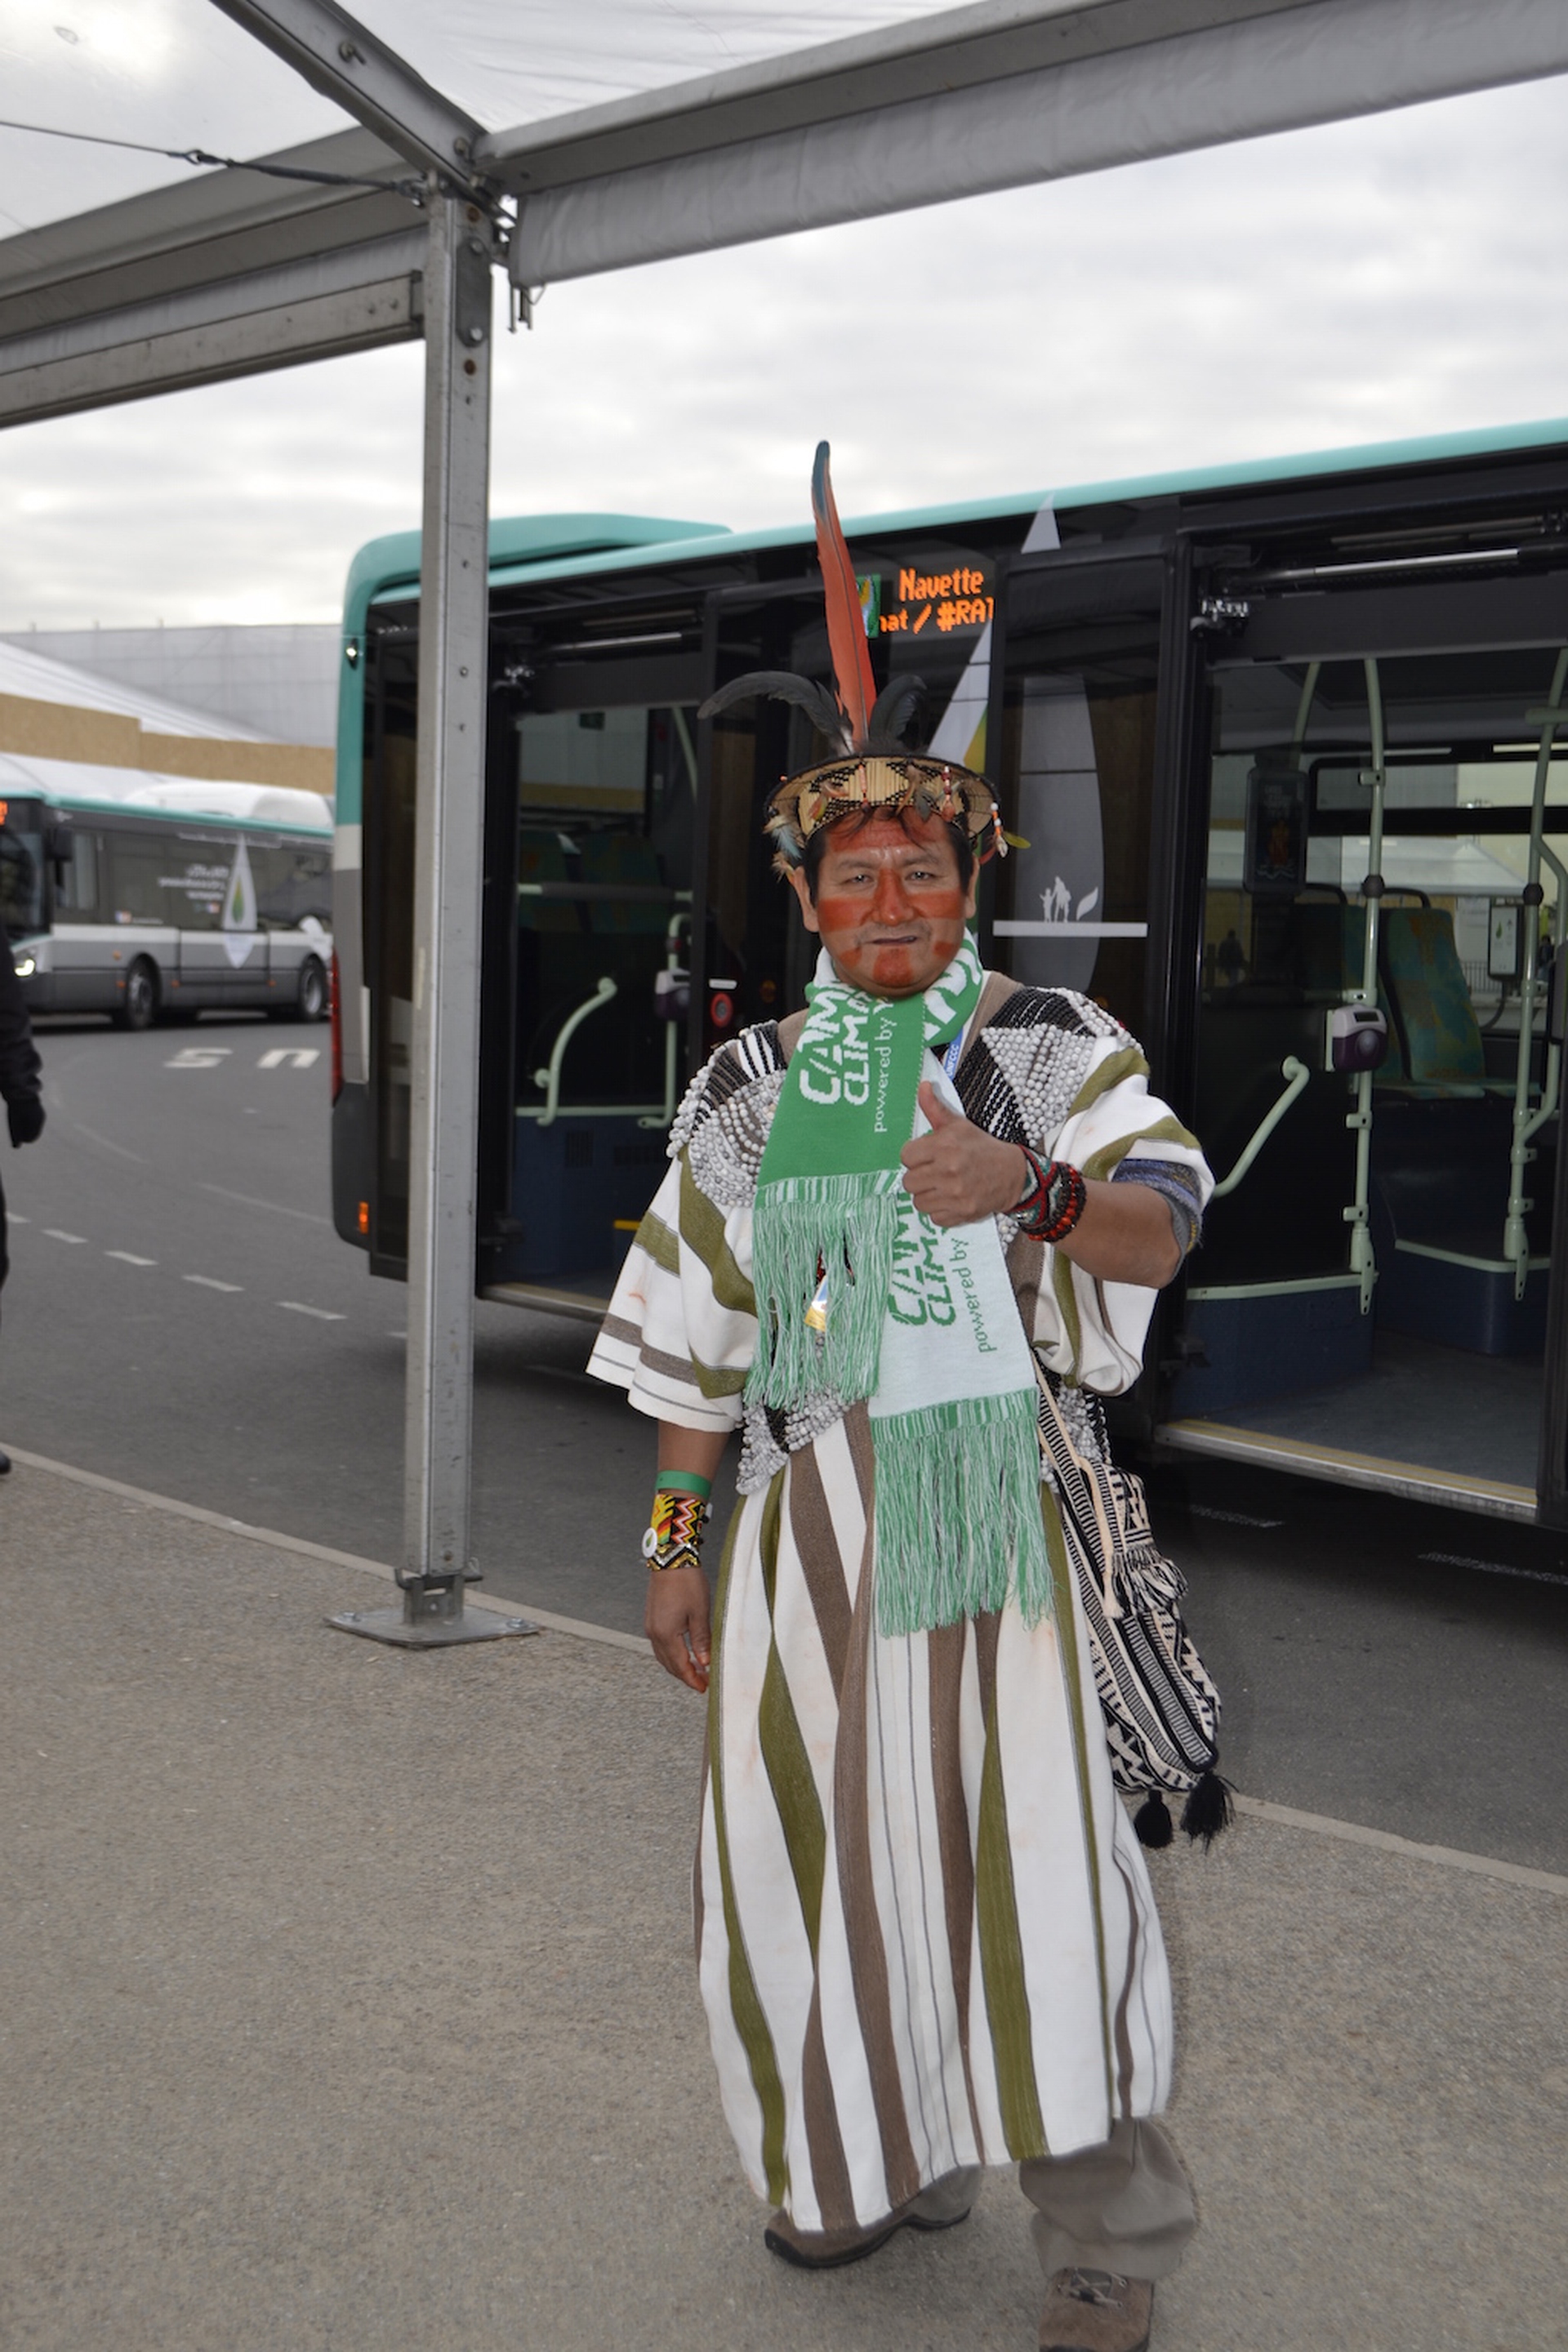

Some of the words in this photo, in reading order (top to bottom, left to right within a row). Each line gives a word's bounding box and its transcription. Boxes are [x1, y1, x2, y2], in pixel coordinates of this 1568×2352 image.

[899, 567, 984, 602] Navette
[875, 1018, 898, 1040] by
[874, 1047, 893, 1133] powered
[949, 1238, 969, 1262] by
[952, 1267, 997, 1352] powered
